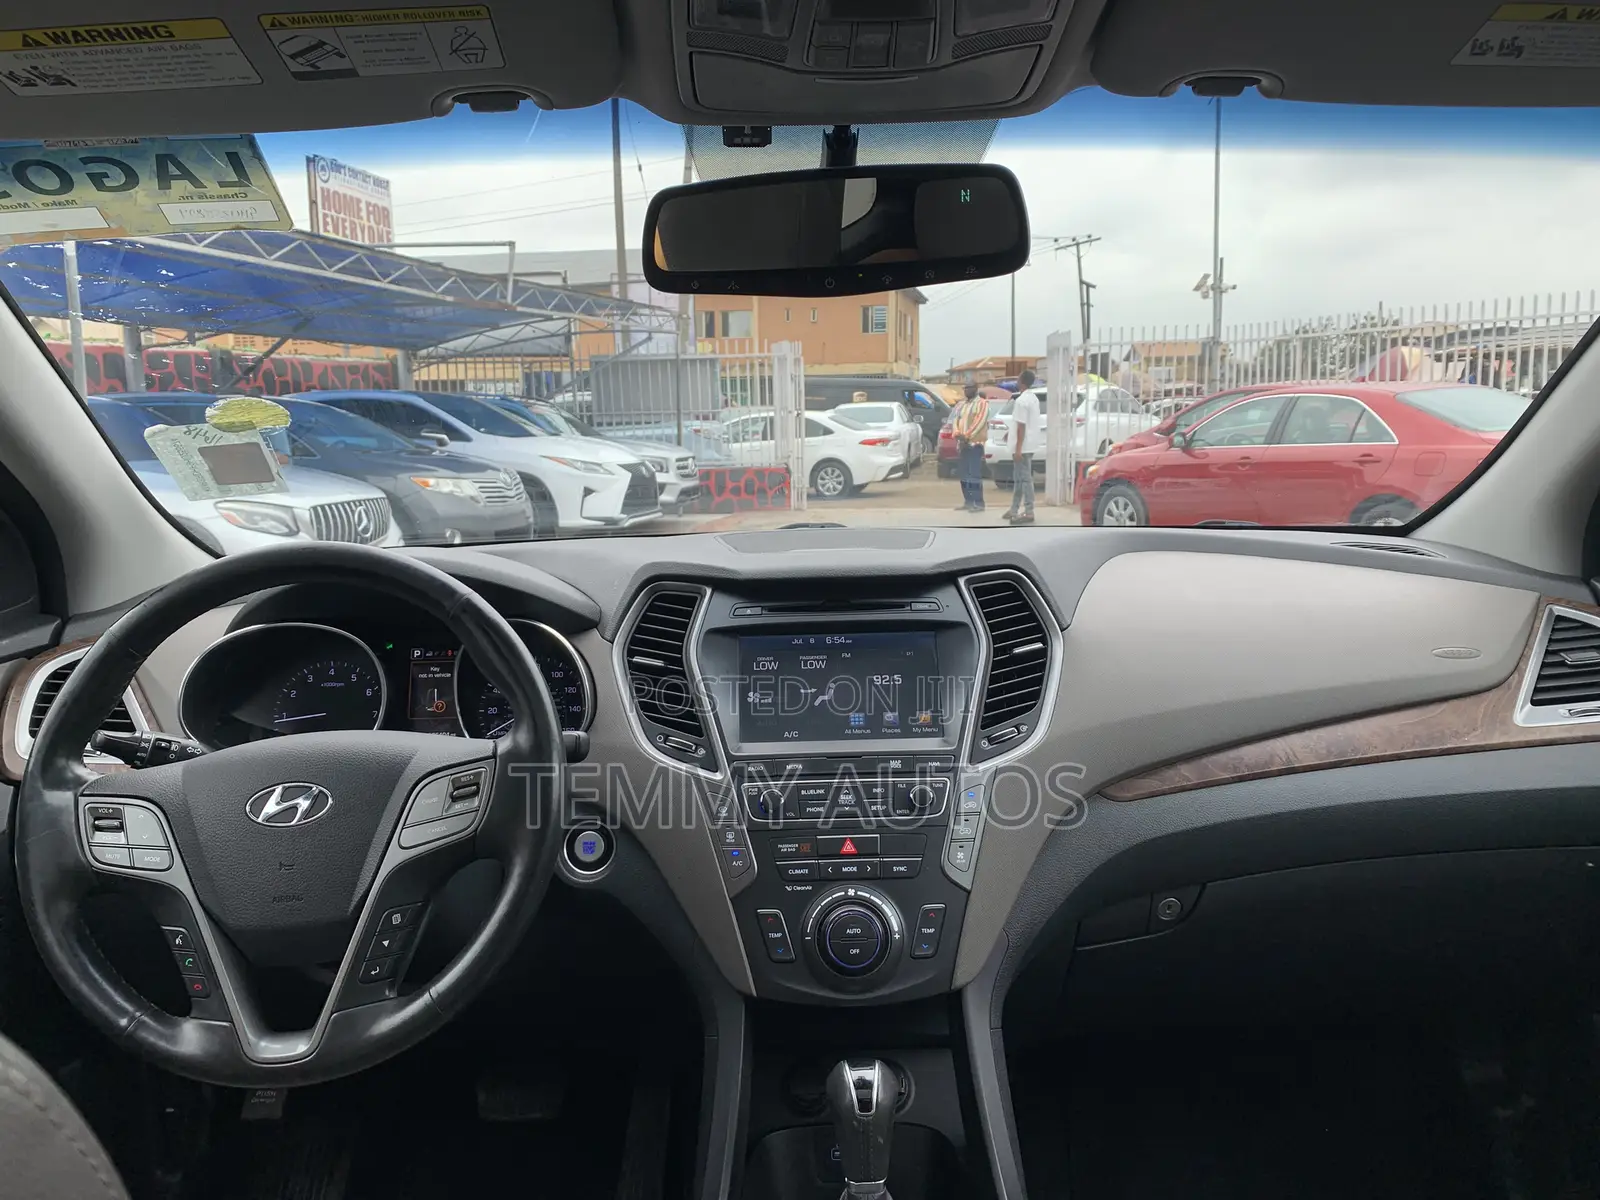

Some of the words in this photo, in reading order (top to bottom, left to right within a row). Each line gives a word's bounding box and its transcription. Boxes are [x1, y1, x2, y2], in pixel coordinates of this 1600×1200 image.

[360, 12, 401, 22] HIGHER
[403, 9, 456, 21] ROLLOVER
[458, 8, 484, 18] RISK
[43, 24, 176, 46] WARNING
[13, 52, 46, 61] EVEN
[49, 50, 79, 59] WITH
[83, 46, 144, 58] ADVANCED
[148, 44, 167, 53] AIR
[170, 42, 203, 51] BAGS
[961, 189, 970, 203] N
[320, 186, 364, 220] HOME
[365, 200, 391, 230] FOR
[323, 212, 393, 243] EVERYONE
[791, 637, 804, 645] Jul
[825, 636, 846, 644] 6:54
[413, 650, 421, 659] P
[753, 661, 779, 671] LOW
[801, 660, 827, 670] LOW
[328, 668, 335, 676] 4
[307, 674, 313, 683] 3
[351, 673, 357, 682] 5
[873, 674, 903, 685] 92.5
[290, 690, 297, 698] 2
[366, 688, 373, 696] 6
[564, 686, 577, 694] 120
[487, 706, 498, 715] 20
[569, 705, 582, 713] 140
[372, 710, 379, 718] 7
[783, 730, 799, 739] A/C
[852, 727, 871, 735] Menus
[881, 727, 901, 735] Places
[801, 788, 826, 796] BLUELINK
[845, 927, 862, 935] AUTO
[921, 927, 936, 935] TEMP
